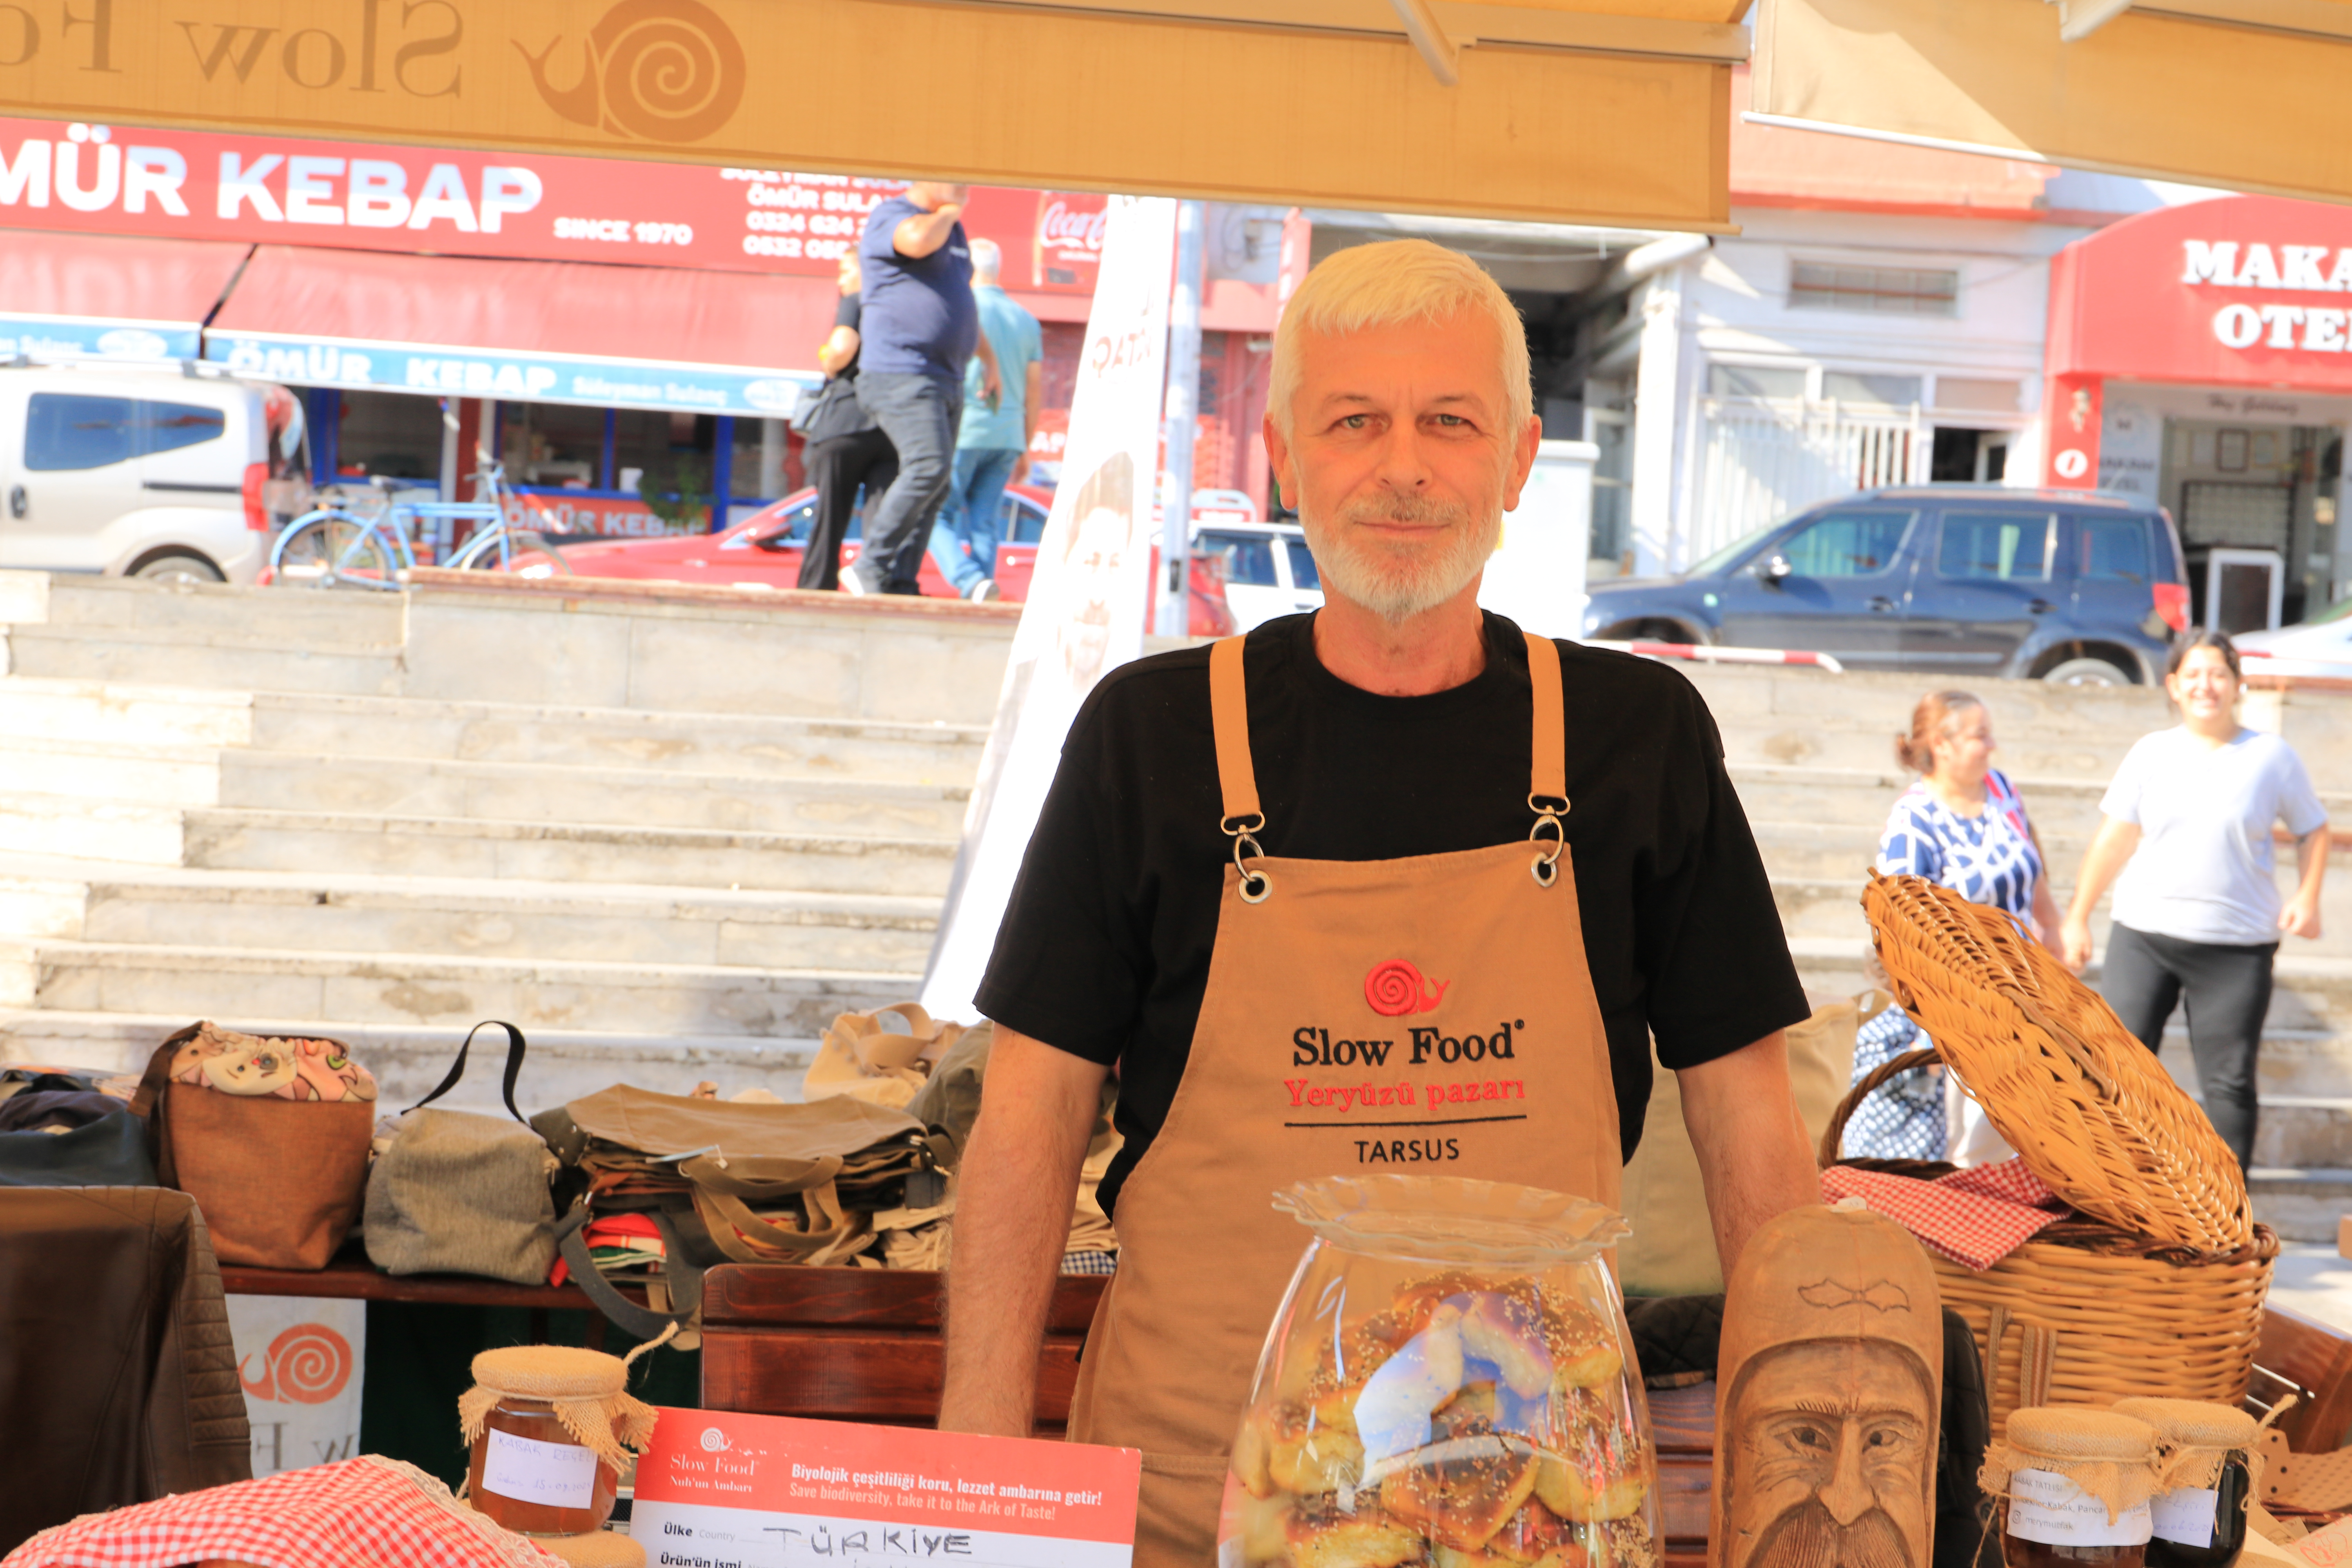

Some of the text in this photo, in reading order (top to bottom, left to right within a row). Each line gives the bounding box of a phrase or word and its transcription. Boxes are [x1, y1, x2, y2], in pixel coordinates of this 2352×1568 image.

[217, 151, 543, 234] KEBAP
[746, 182, 820, 209] ÖMÜR
[554, 218, 693, 245] SINCE 1970
[809, 214, 855, 236] 624
[2213, 303, 2352, 352] OTE
[228, 339, 372, 383] ÖMÜR
[406, 357, 557, 395] KEBAP
[1293, 1027, 1394, 1067] Slow
[1284, 1078, 1526, 1112] Yeryüzü pazarı
[1354, 1138, 1459, 1163] TARSUS
[670, 1453, 755, 1476] Slow Food
[670, 1475, 709, 1489] Nuh'un
[791, 1463, 1103, 1506] Biyolojik çeşitliliği koru, lezzet ambarına getir!
[789, 1482, 1056, 1521] Save biodiversity, take it to the Ark of Taste!
[664, 1522, 736, 1543] Ülke Country
[661, 1552, 711, 1568] Ürün'ün
